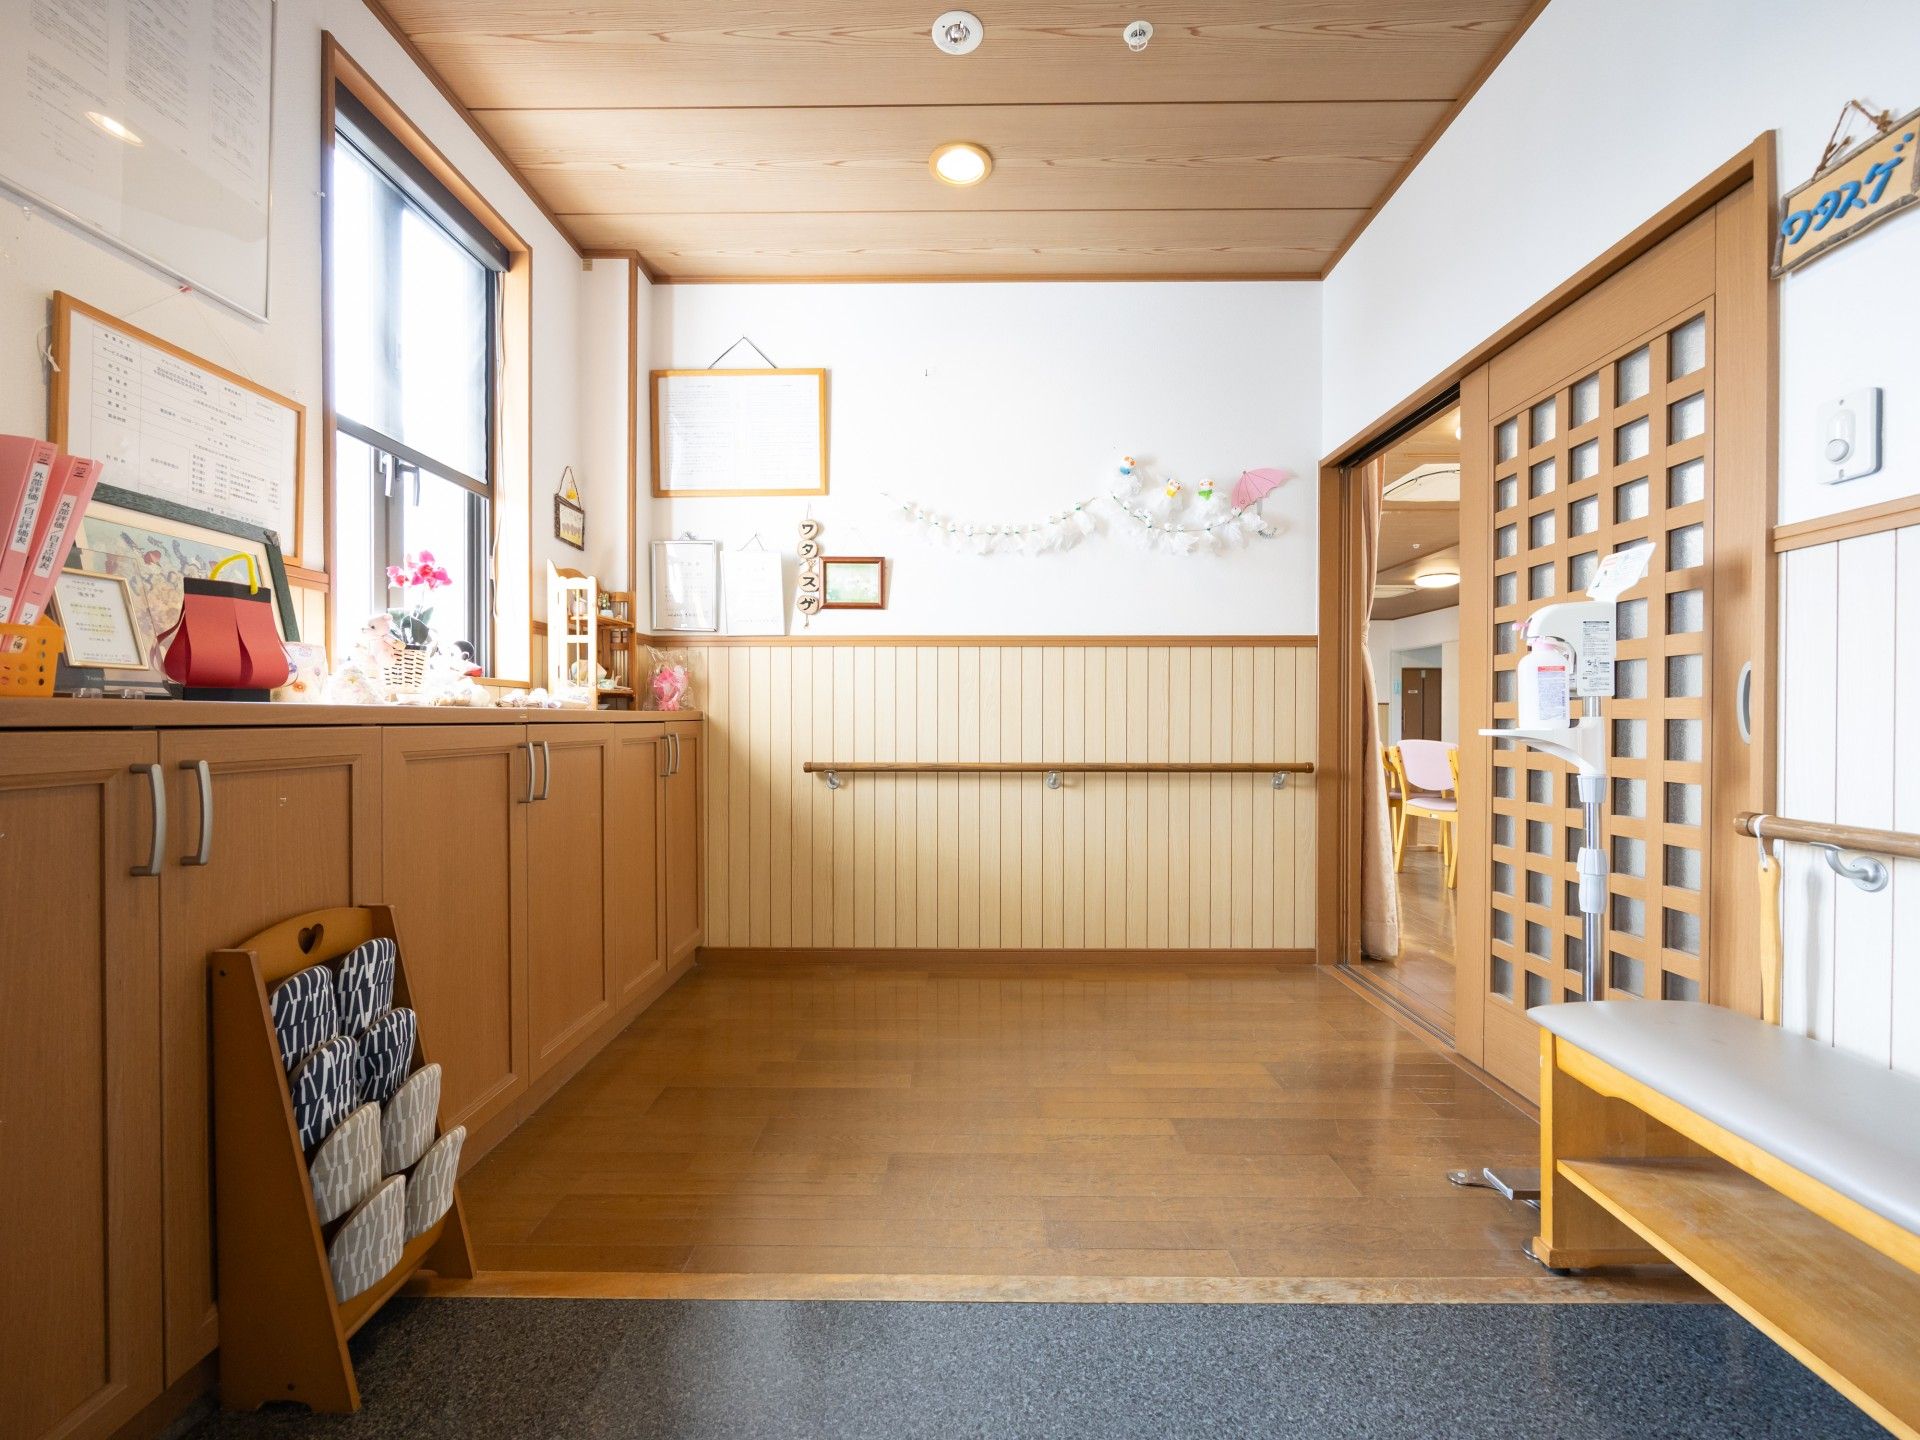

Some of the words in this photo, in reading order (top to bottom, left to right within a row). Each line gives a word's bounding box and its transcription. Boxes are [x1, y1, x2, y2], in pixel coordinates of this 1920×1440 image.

[1782, 132, 1915, 245] ワタスゲ
[800, 524, 816, 611] ワタスゲ
